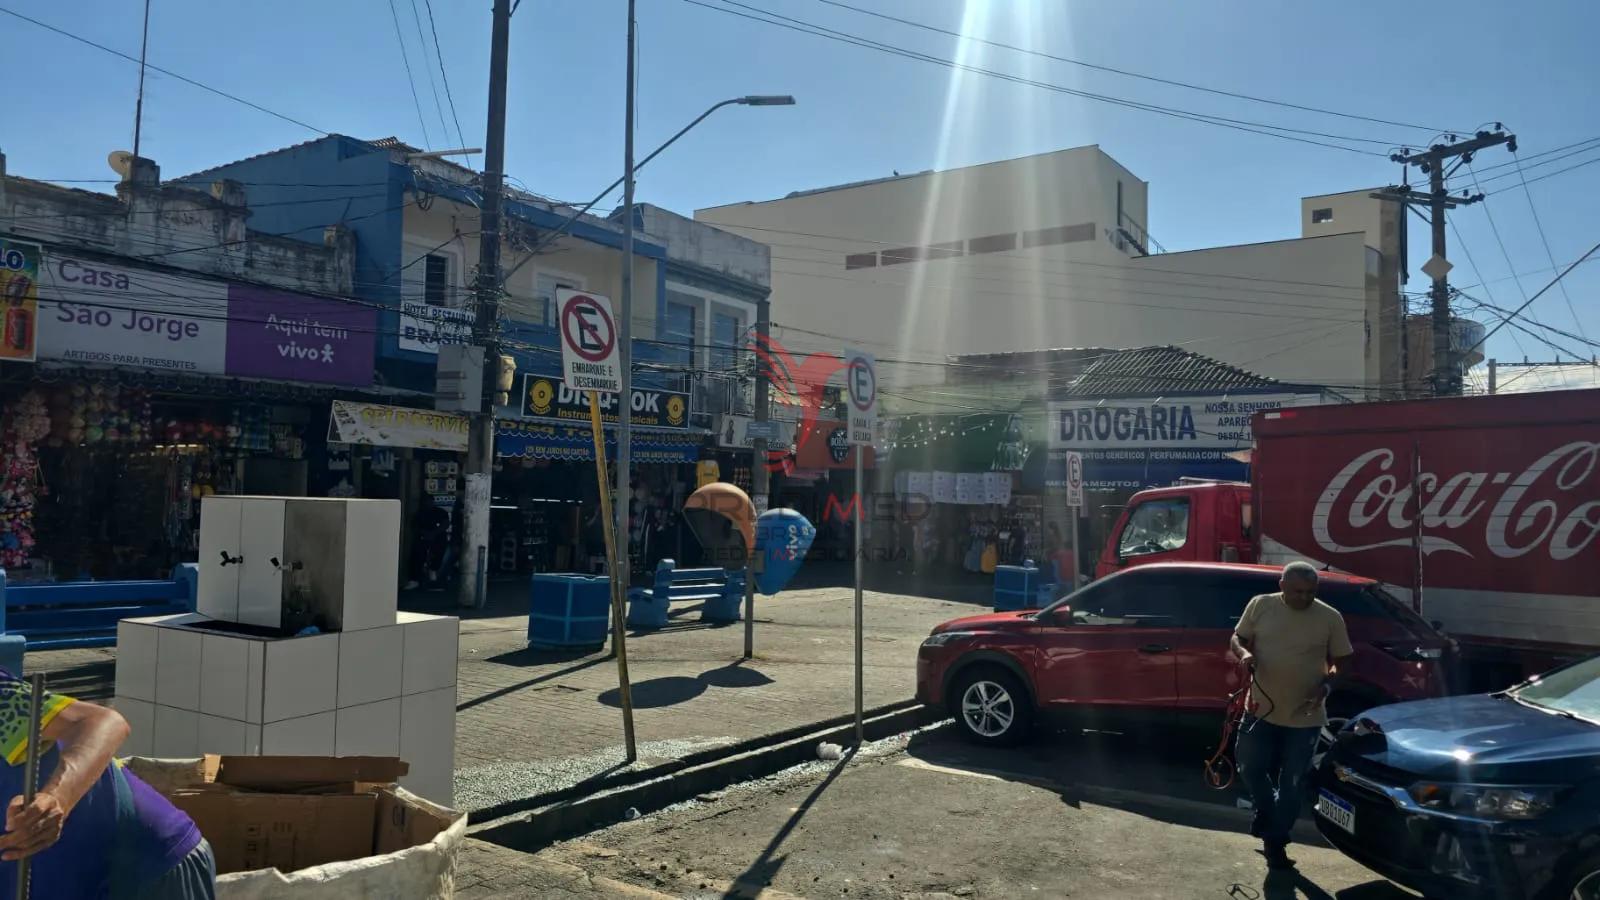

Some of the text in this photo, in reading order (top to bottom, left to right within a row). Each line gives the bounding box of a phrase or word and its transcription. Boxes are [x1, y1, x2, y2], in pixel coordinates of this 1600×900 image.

[59, 258, 130, 290] Casa
[57, 301, 200, 341] São Jorge
[264, 312, 349, 340] Aqui tem
[63, 350, 198, 371] ARTIGOS PARA PRESENTES
[277, 341, 319, 361] vivo
[571, 362, 614, 377] EMBARQUE E
[573, 376, 618, 391] DESEMBARQUE
[556, 382, 660, 414] DISQ-OK
[1204, 401, 1235, 414] NOSSA
[557, 407, 619, 424] Instrumntos
[629, 414, 659, 426] usicais
[1060, 405, 1197, 442] DROGARIA
[1217, 432, 1244, 441] DESDE
[1149, 451, 1200, 460] PERFUMARIA
[1201, 451, 1219, 460] COM
